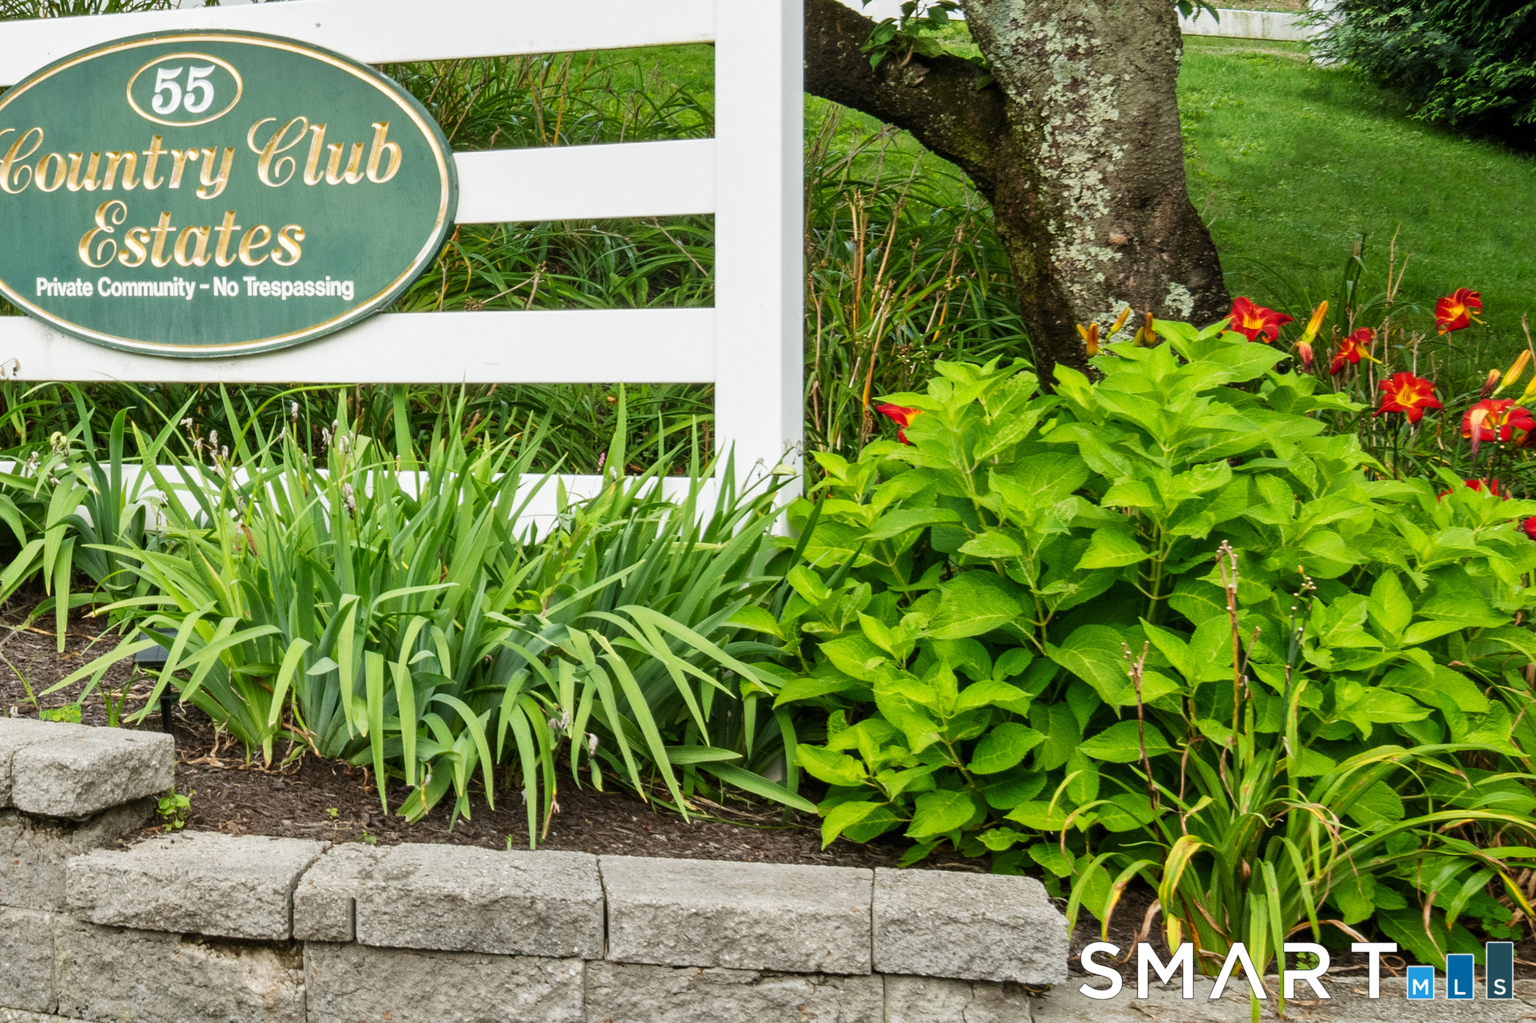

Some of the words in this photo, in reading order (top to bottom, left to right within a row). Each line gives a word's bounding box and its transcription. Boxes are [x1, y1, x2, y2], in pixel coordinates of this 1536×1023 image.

[151, 65, 216, 115] 55
[247, 116, 402, 187] Club
[78, 199, 306, 268] Estates
[36, 277, 93, 298] Private
[97, 276, 196, 300] Community
[213, 276, 239, 297] No
[243, 276, 355, 301] Trespassing
